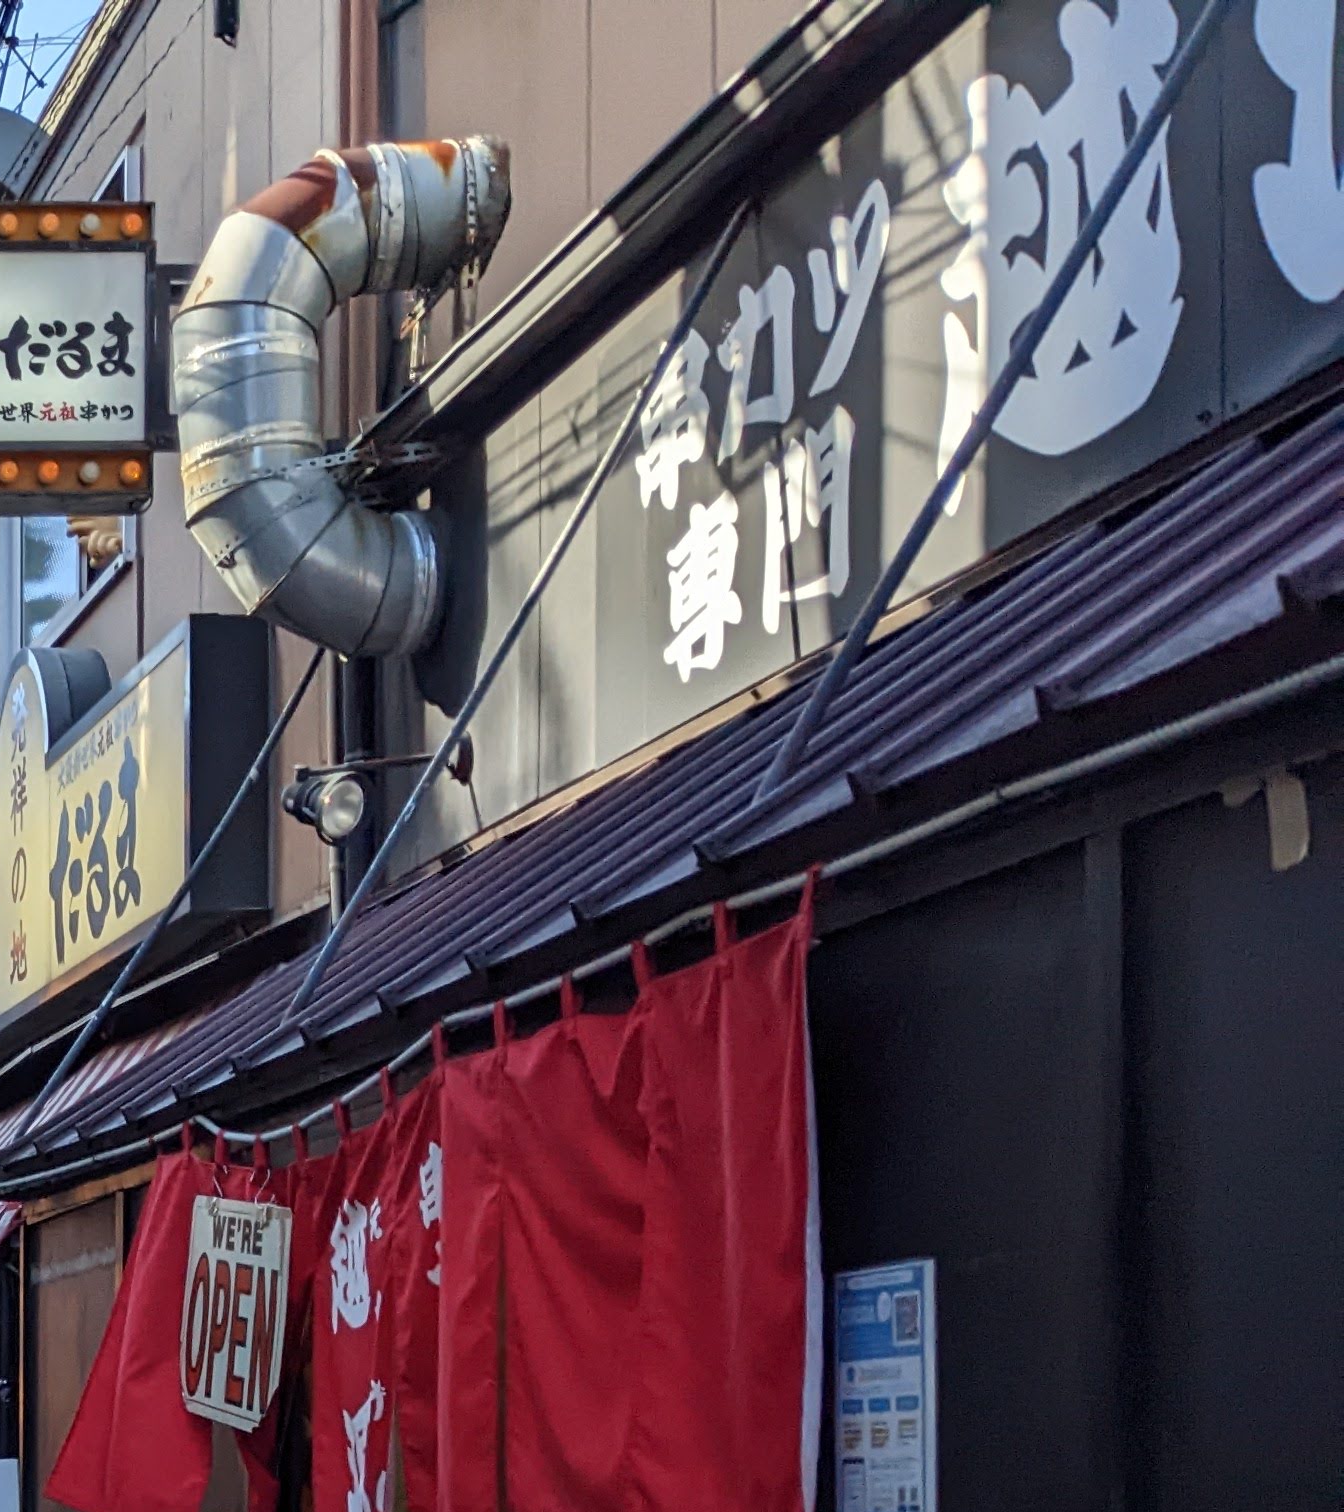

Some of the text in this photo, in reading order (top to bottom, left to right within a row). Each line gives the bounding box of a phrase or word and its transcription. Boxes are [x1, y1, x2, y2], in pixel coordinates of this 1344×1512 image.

[48, 736, 142, 965] だるま
[213, 1215, 265, 1257] WE'RE
[184, 1251, 280, 1416] OPEN
